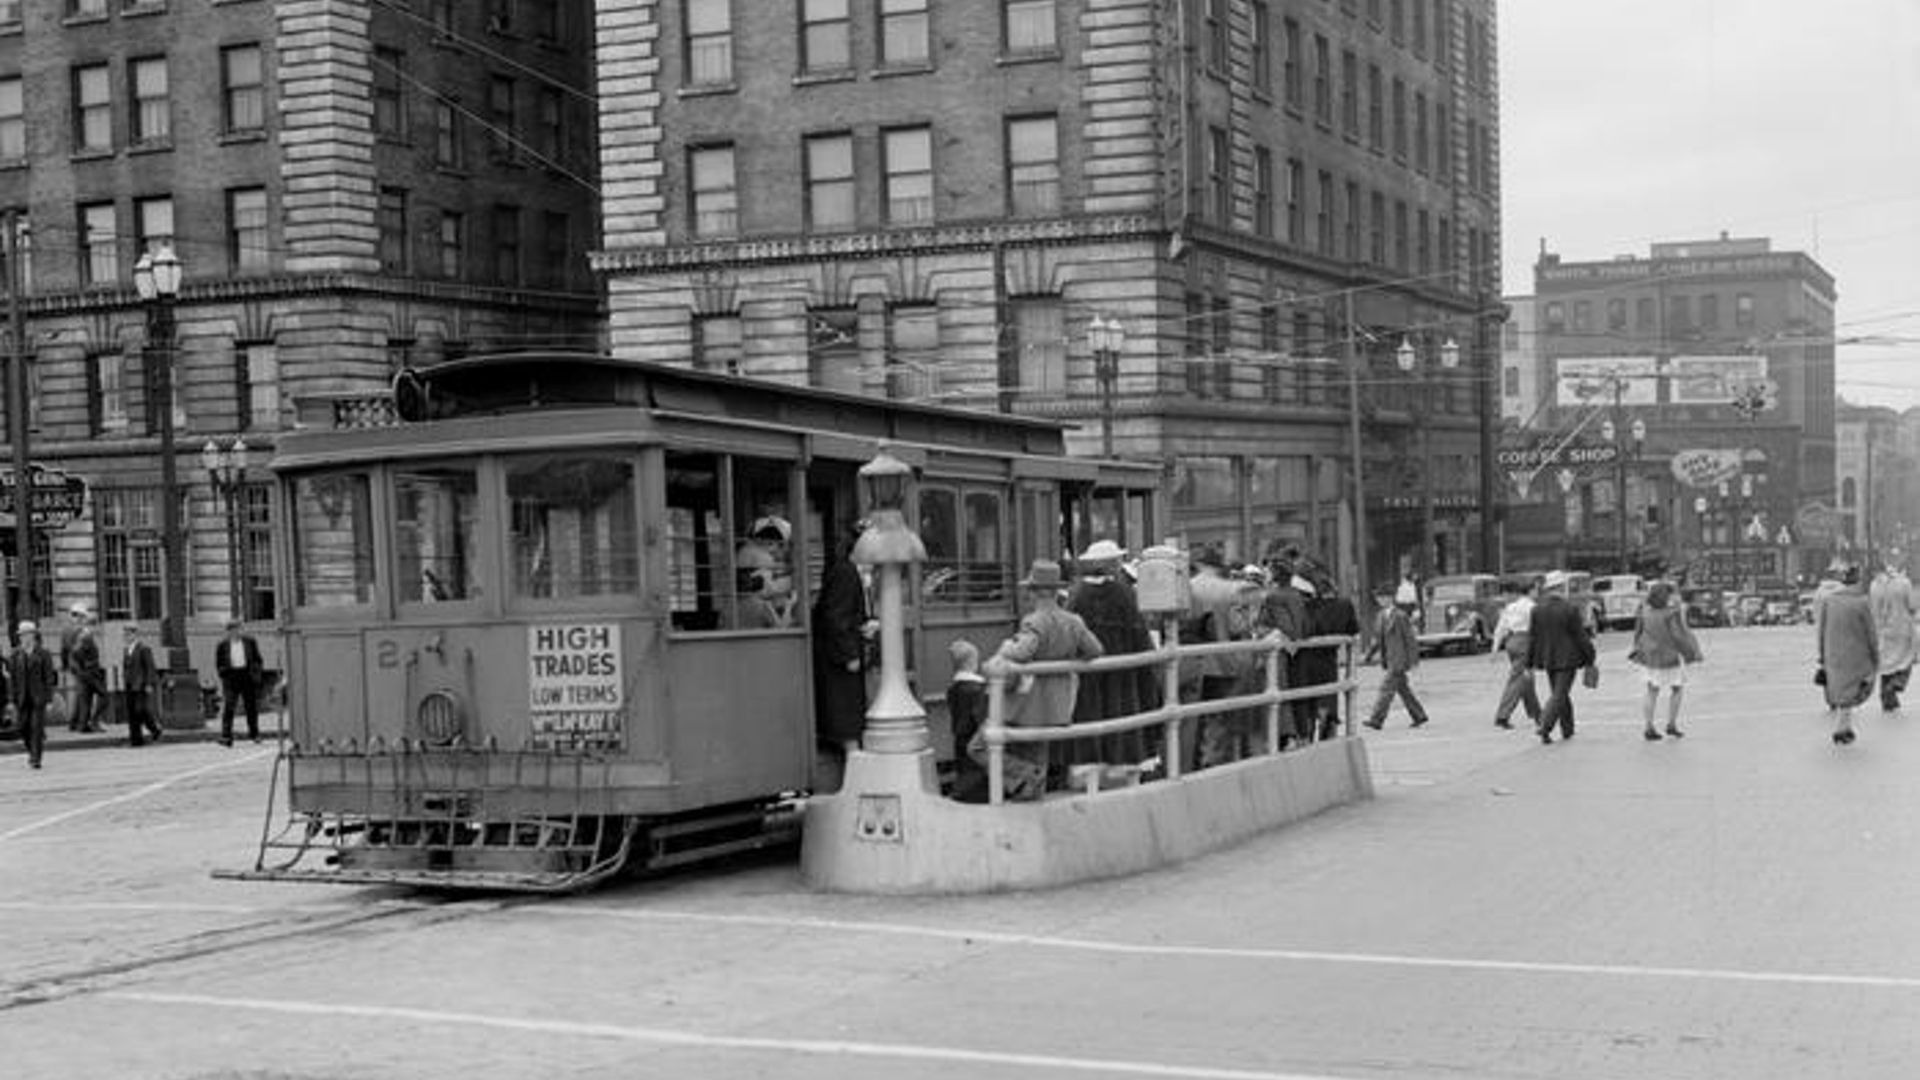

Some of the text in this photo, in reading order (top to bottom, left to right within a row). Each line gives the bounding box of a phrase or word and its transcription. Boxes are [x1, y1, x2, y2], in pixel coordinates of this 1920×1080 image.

[1568, 448, 1616, 462] SHOP
[537, 627, 610, 650] HIGH
[532, 653, 616, 676] TRADES
[532, 684, 619, 706] LOW TERMS
